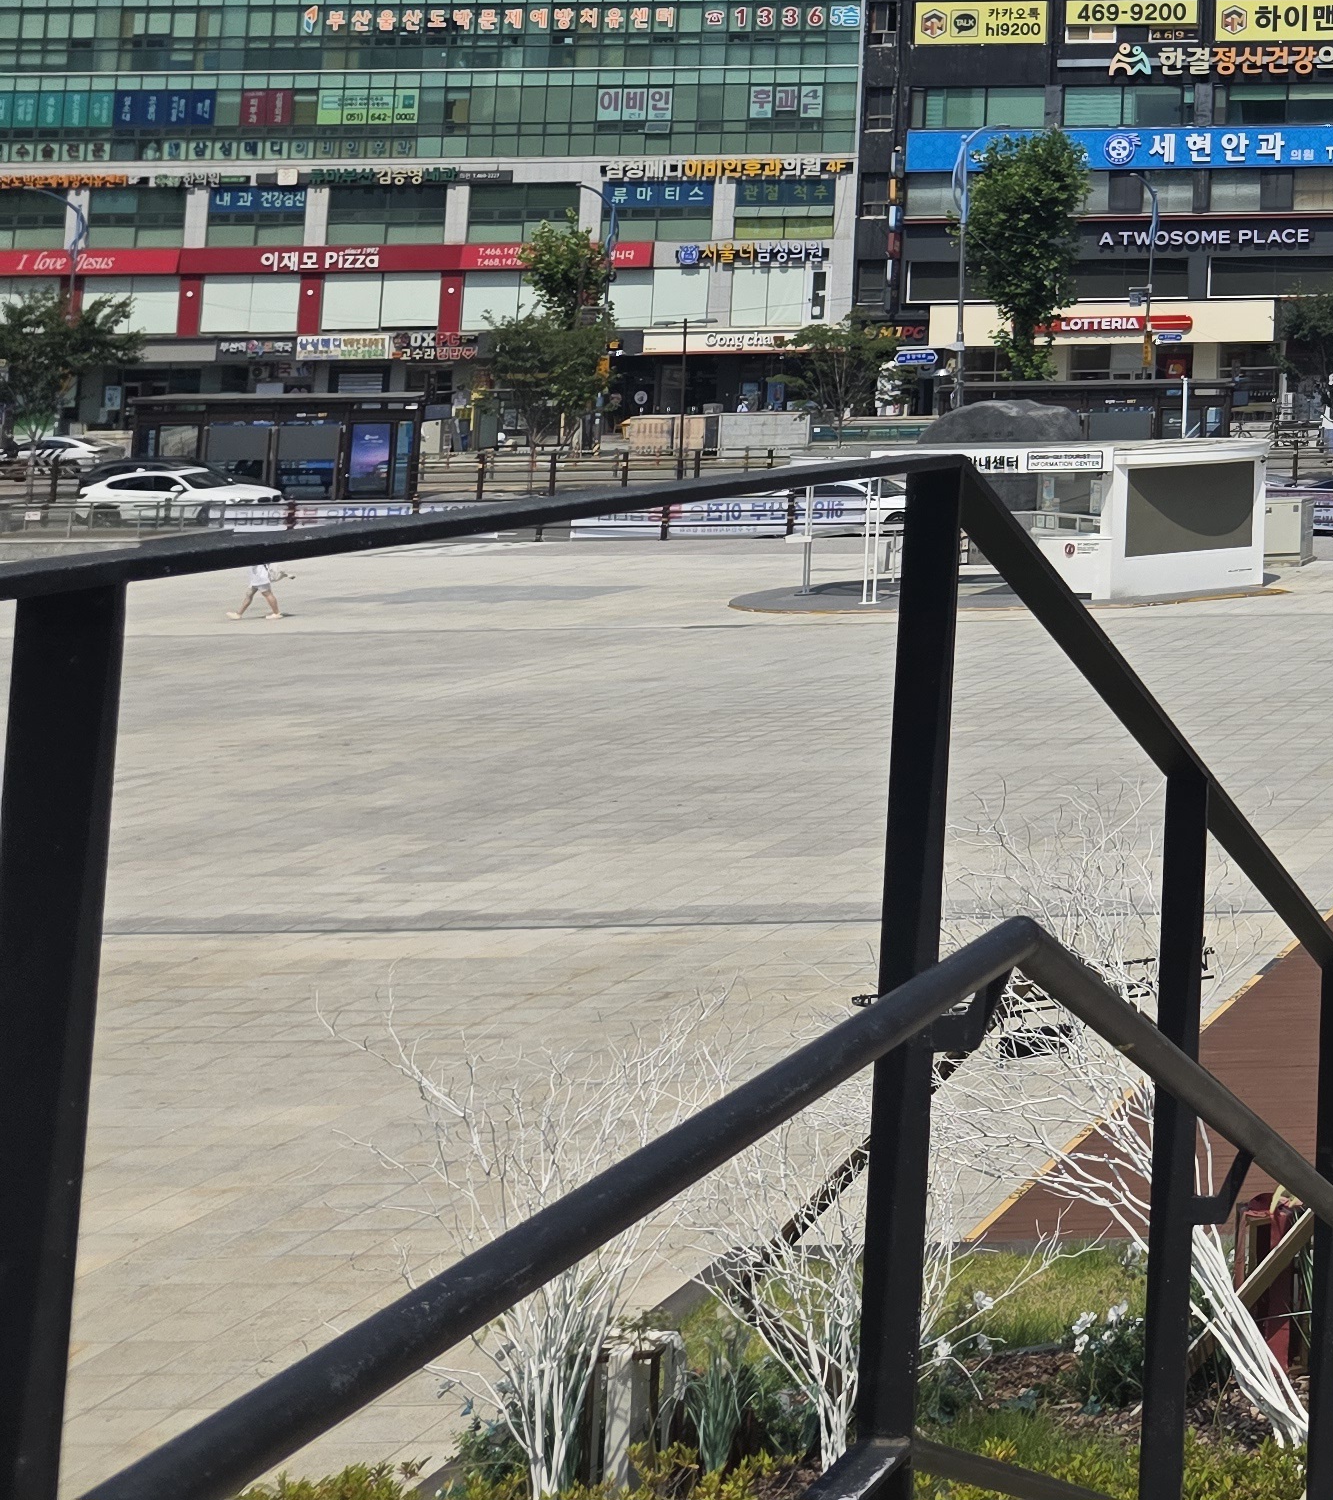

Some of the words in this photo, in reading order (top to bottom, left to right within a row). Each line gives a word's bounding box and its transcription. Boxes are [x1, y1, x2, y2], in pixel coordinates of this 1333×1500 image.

[736, 6, 824, 28] 1336
[829, 5, 861, 28] 5층
[988, 7, 1041, 20] 카카오톡
[1078, 4, 1187, 22] 469-9200
[1149, 132, 1286, 164] 세현안과
[825, 160, 847, 173] 4F
[260, 191, 306, 208] 건강검진
[612, 186, 705, 204] 류마티스
[1098, 232, 1114, 246] A
[1117, 230, 1230, 246] TWOSOME
[1237, 228, 1309, 244] PLACE
[33, 252, 66, 270] love
[75, 254, 116, 272] Jesus
[260, 251, 319, 271] 이재모
[324, 252, 380, 269] Pizza
[1060, 317, 1139, 331] LOTTERIA
[705, 332, 744, 350] Gong
[746, 332, 773, 347] cha
[1075, 460, 1100, 468] CENTER
